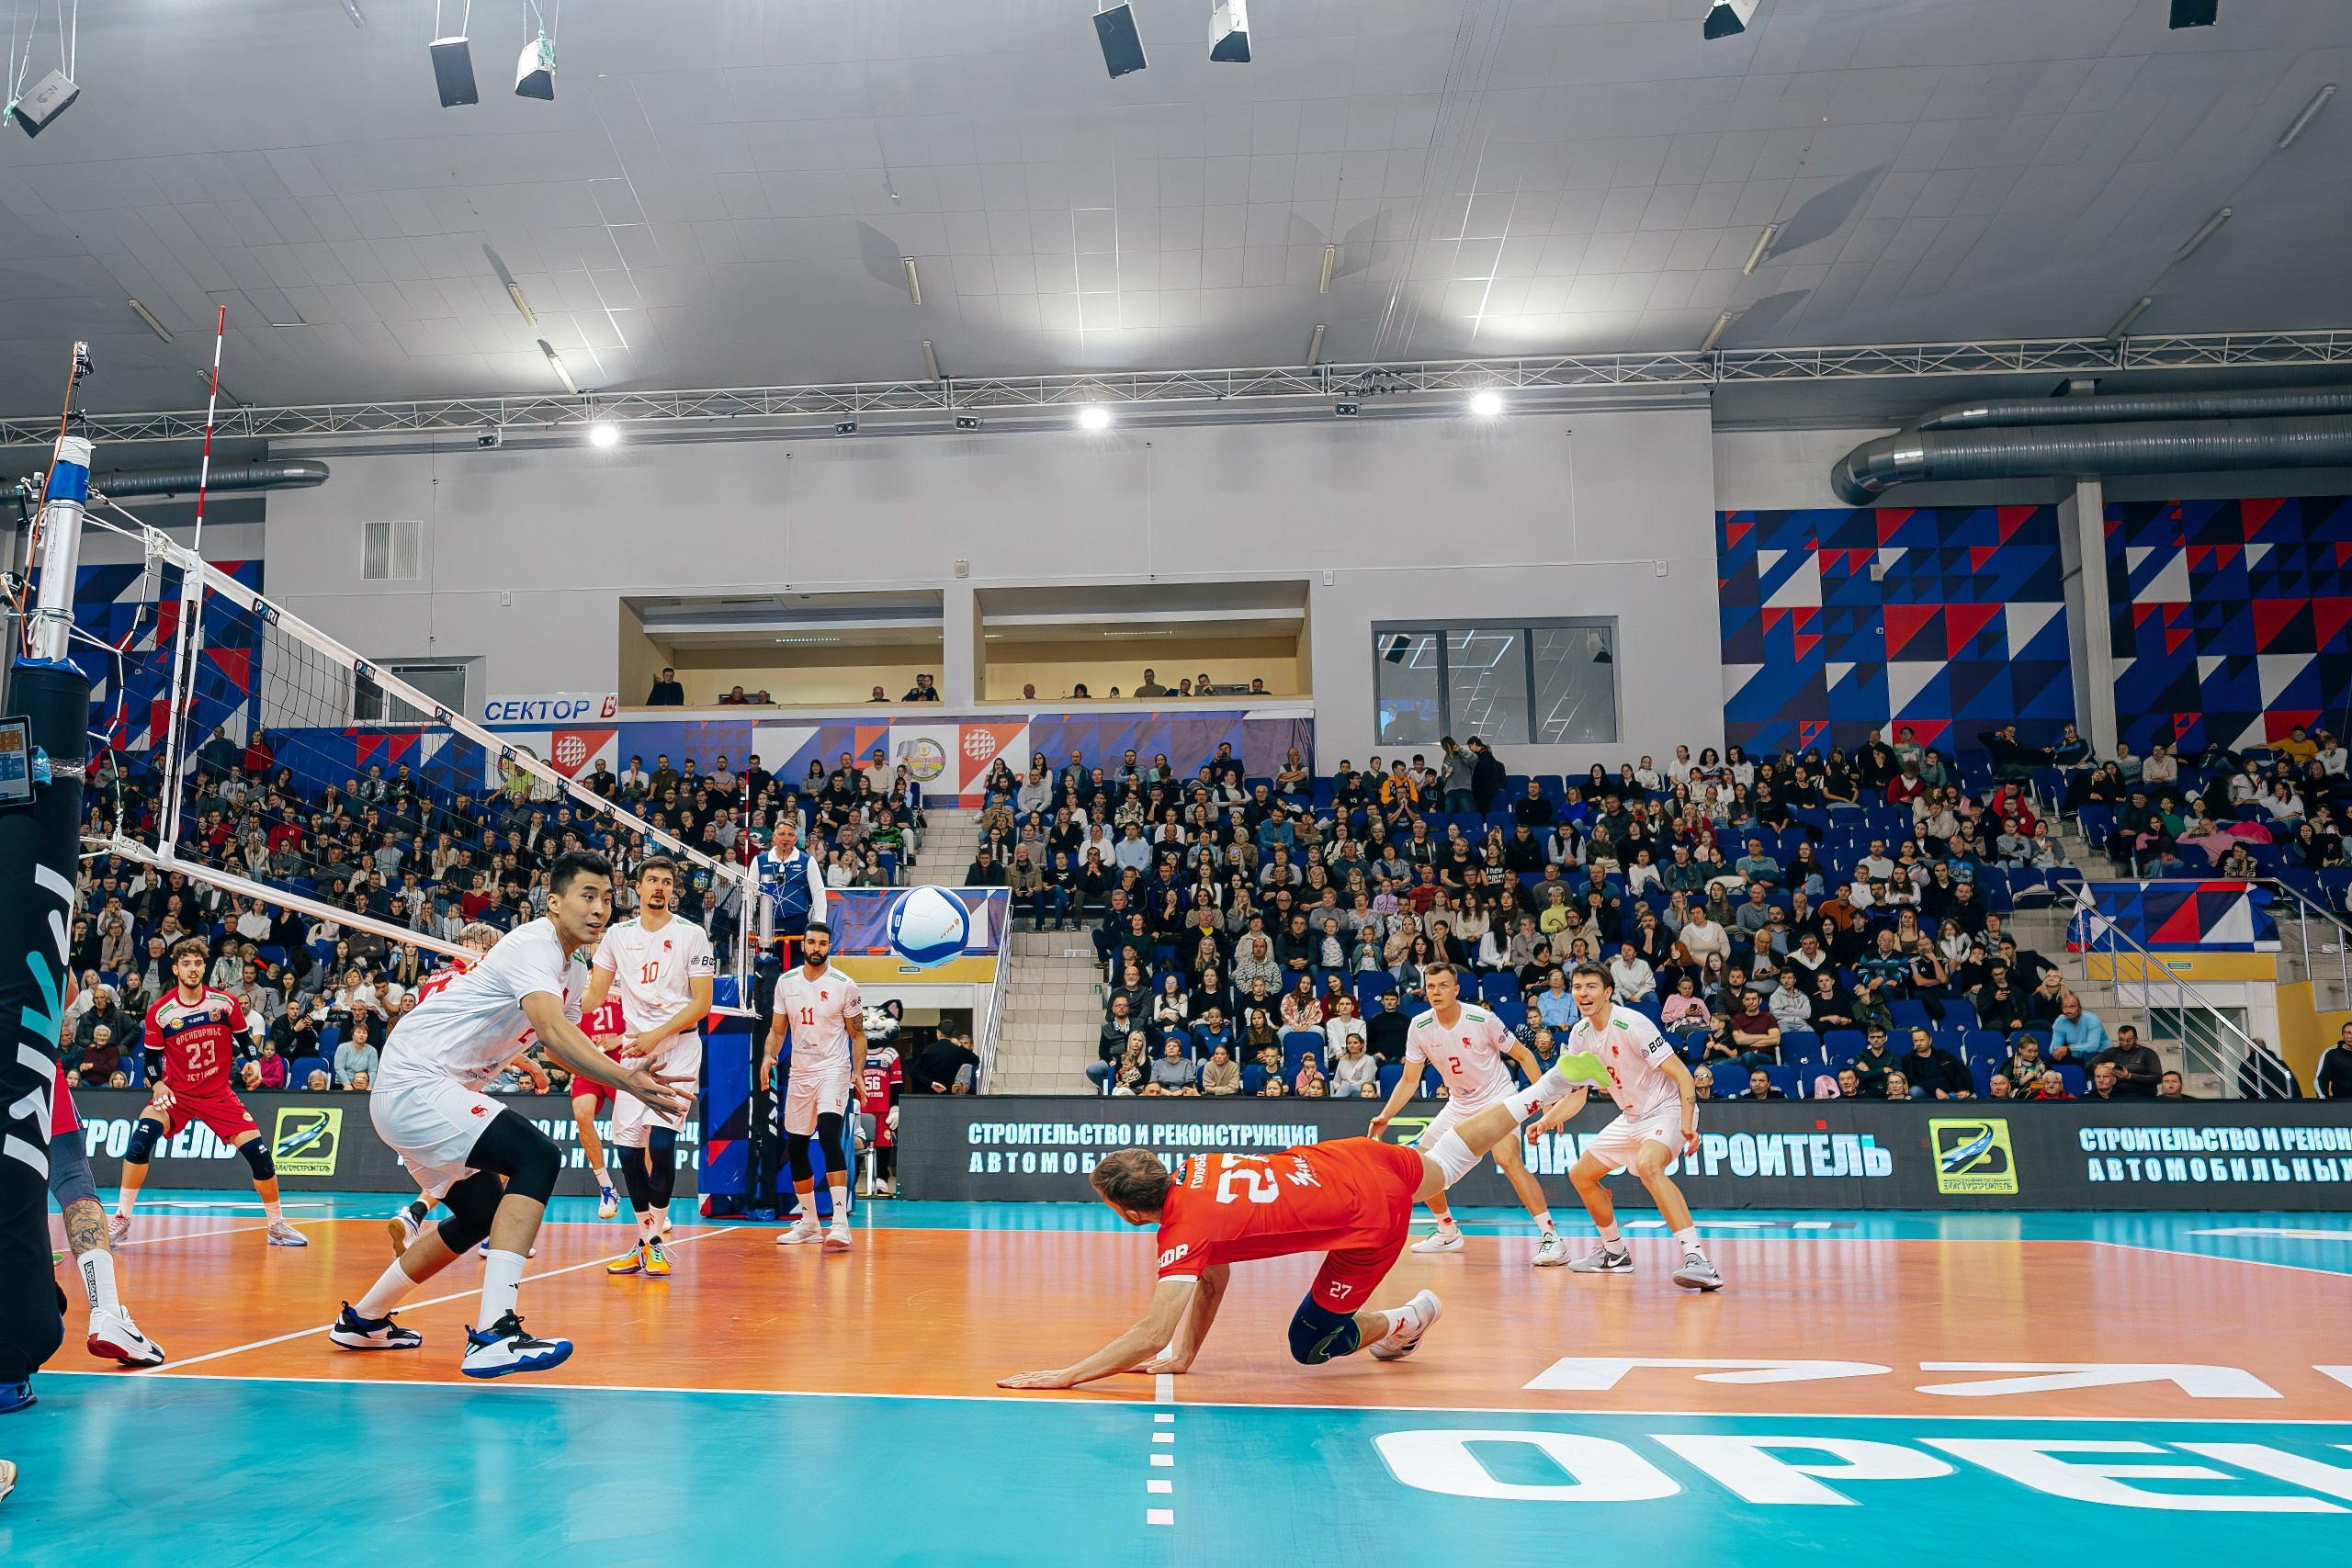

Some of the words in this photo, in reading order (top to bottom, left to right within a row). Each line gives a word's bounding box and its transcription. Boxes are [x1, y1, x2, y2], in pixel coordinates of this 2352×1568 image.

[485, 700, 590, 721] СЕКТОР
[640, 961, 659, 985] 10
[593, 1006, 614, 1031] 21
[800, 1007, 815, 1025] 11
[186, 1039, 216, 1070] 23
[1448, 1056, 1464, 1075] 2
[864, 1076, 881, 1090] 56
[968, 1123, 1129, 1145] СТРОИТЕЛЬСТВО
[1135, 1123, 1148, 1145] И
[1152, 1123, 1318, 1149] РЕКОНСТРУКЦИЯ
[2079, 1126, 2260, 1152] СТРОИТЕЛЬСТВО
[2262, 1128, 2279, 1151] И
[1329, 1280, 1353, 1300] 27
